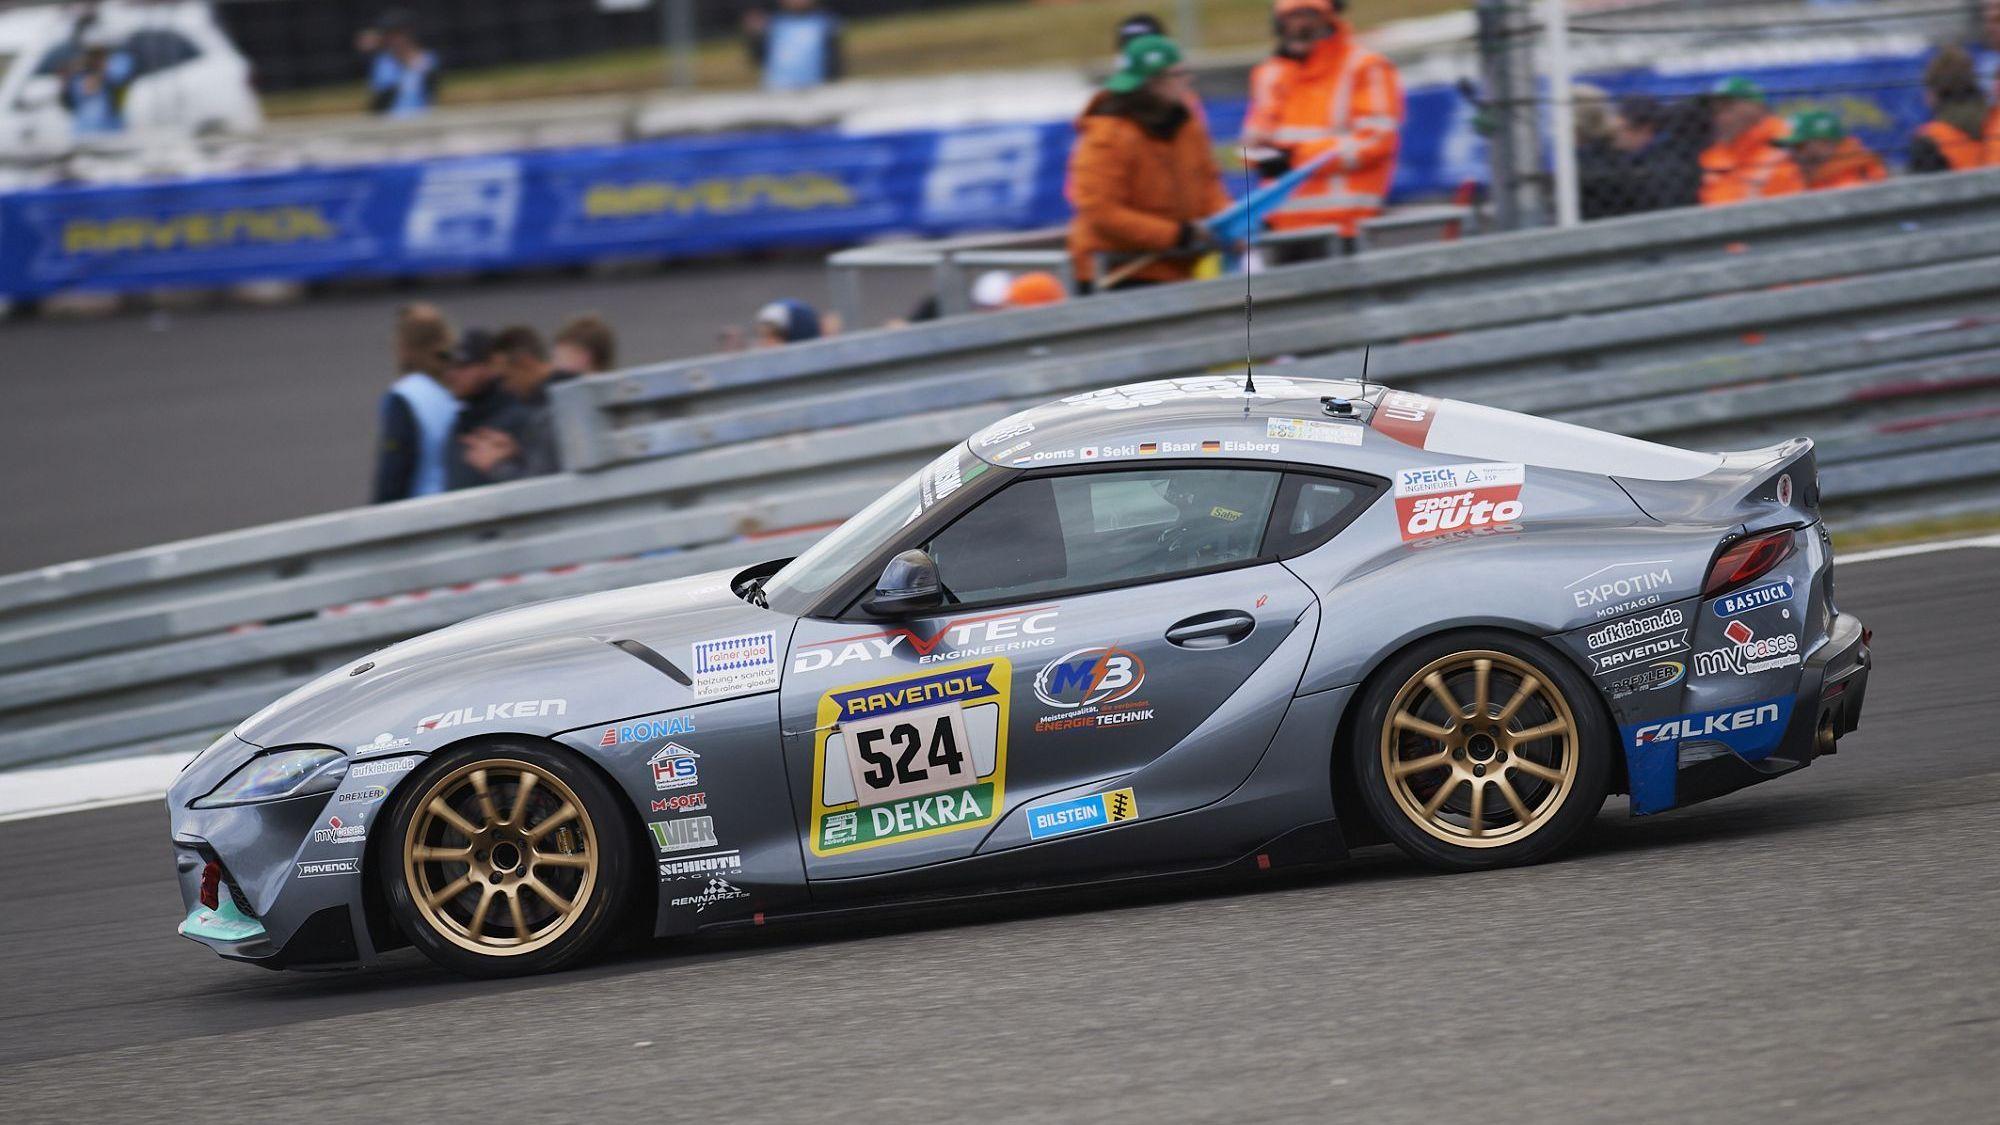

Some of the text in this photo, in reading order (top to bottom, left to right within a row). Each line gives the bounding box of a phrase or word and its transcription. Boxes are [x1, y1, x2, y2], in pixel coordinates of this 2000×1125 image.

[1034, 449, 1075, 460] Ooms
[1103, 446, 1135, 457] Seki
[1162, 442, 1196, 452] Baar
[1405, 480, 1455, 493] INGENIEURE
[1413, 491, 1474, 513] sport
[1407, 500, 1523, 534] auto
[1573, 569, 1672, 608] EXPOTIM
[1725, 585, 1787, 613] BASTUCK
[1596, 595, 1660, 618] MONTAGGI
[1587, 609, 1683, 649] aufkleben.de
[709, 650, 741, 662] rainer
[918, 637, 1056, 664] ENGINEERING
[1600, 638, 1681, 668] RAVENOL
[847, 676, 983, 714] RAVENOL
[415, 699, 567, 734] FALKEN
[620, 716, 695, 743] RONAL
[1635, 703, 1778, 747] FALKEN
[856, 716, 963, 789] 524
[352, 757, 415, 778] aufkleben.de
[653, 758, 697, 780] HS
[339, 790, 380, 802] DREXLER
[871, 790, 982, 837] DEKRA
[1037, 804, 1098, 829] BILSTEIN
[303, 862, 353, 874] RAVENOL
[660, 855, 741, 876] SCHROTH
[661, 869, 742, 882] RACING
